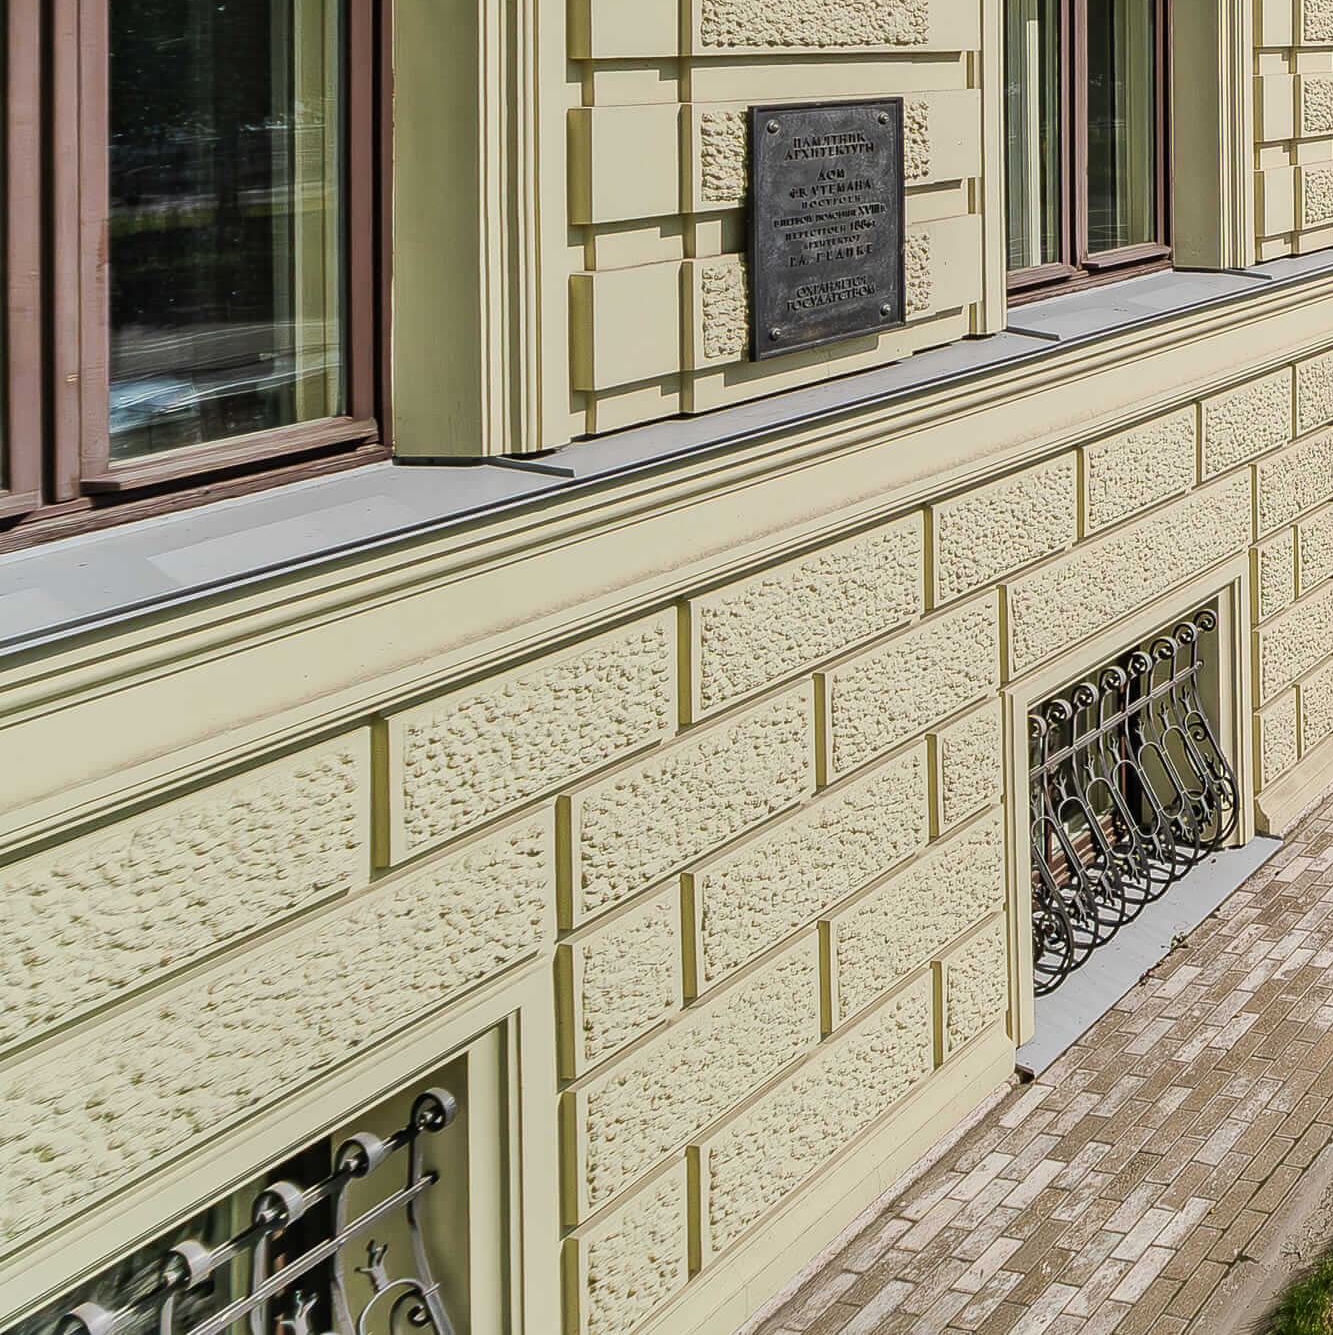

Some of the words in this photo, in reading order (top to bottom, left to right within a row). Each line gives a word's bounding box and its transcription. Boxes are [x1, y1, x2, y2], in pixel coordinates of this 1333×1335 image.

[793, 132, 866, 148] ПАМЯТНИК
[784, 143, 874, 160] АРХИТЕКТУРЫ
[817, 168, 846, 181] ДОМ
[811, 179, 872, 196] УТЕМАНА
[816, 244, 873, 263] ГЕДИКЕ
[796, 276, 867, 298] ОХРАНЯЕТСЯ
[786, 286, 875, 311] ГОСУДАРСТВОМ
